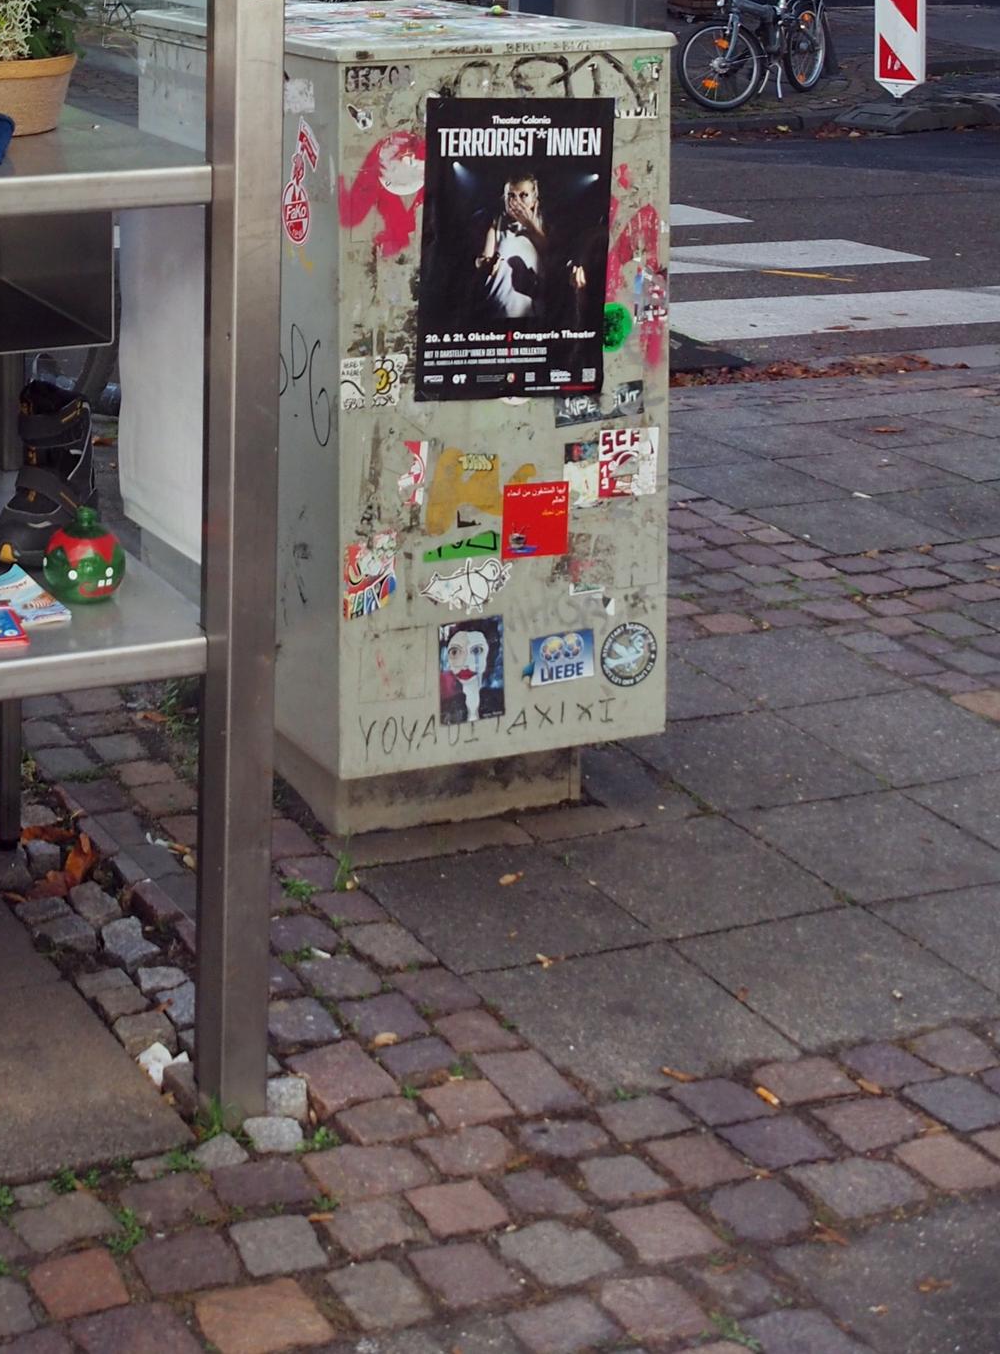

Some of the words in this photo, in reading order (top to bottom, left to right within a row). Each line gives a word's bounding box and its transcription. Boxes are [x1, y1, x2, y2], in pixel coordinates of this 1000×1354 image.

[492, 115, 521, 125] Theater
[522, 115, 551, 125] Colonia
[425, 334, 441, 343] 20.
[453, 333, 467, 343] 21.
[468, 332, 506, 343] Oktober
[513, 330, 559, 342] Orangerie
[561, 329, 596, 339] Theater
[540, 661, 585, 683] LIEBE
